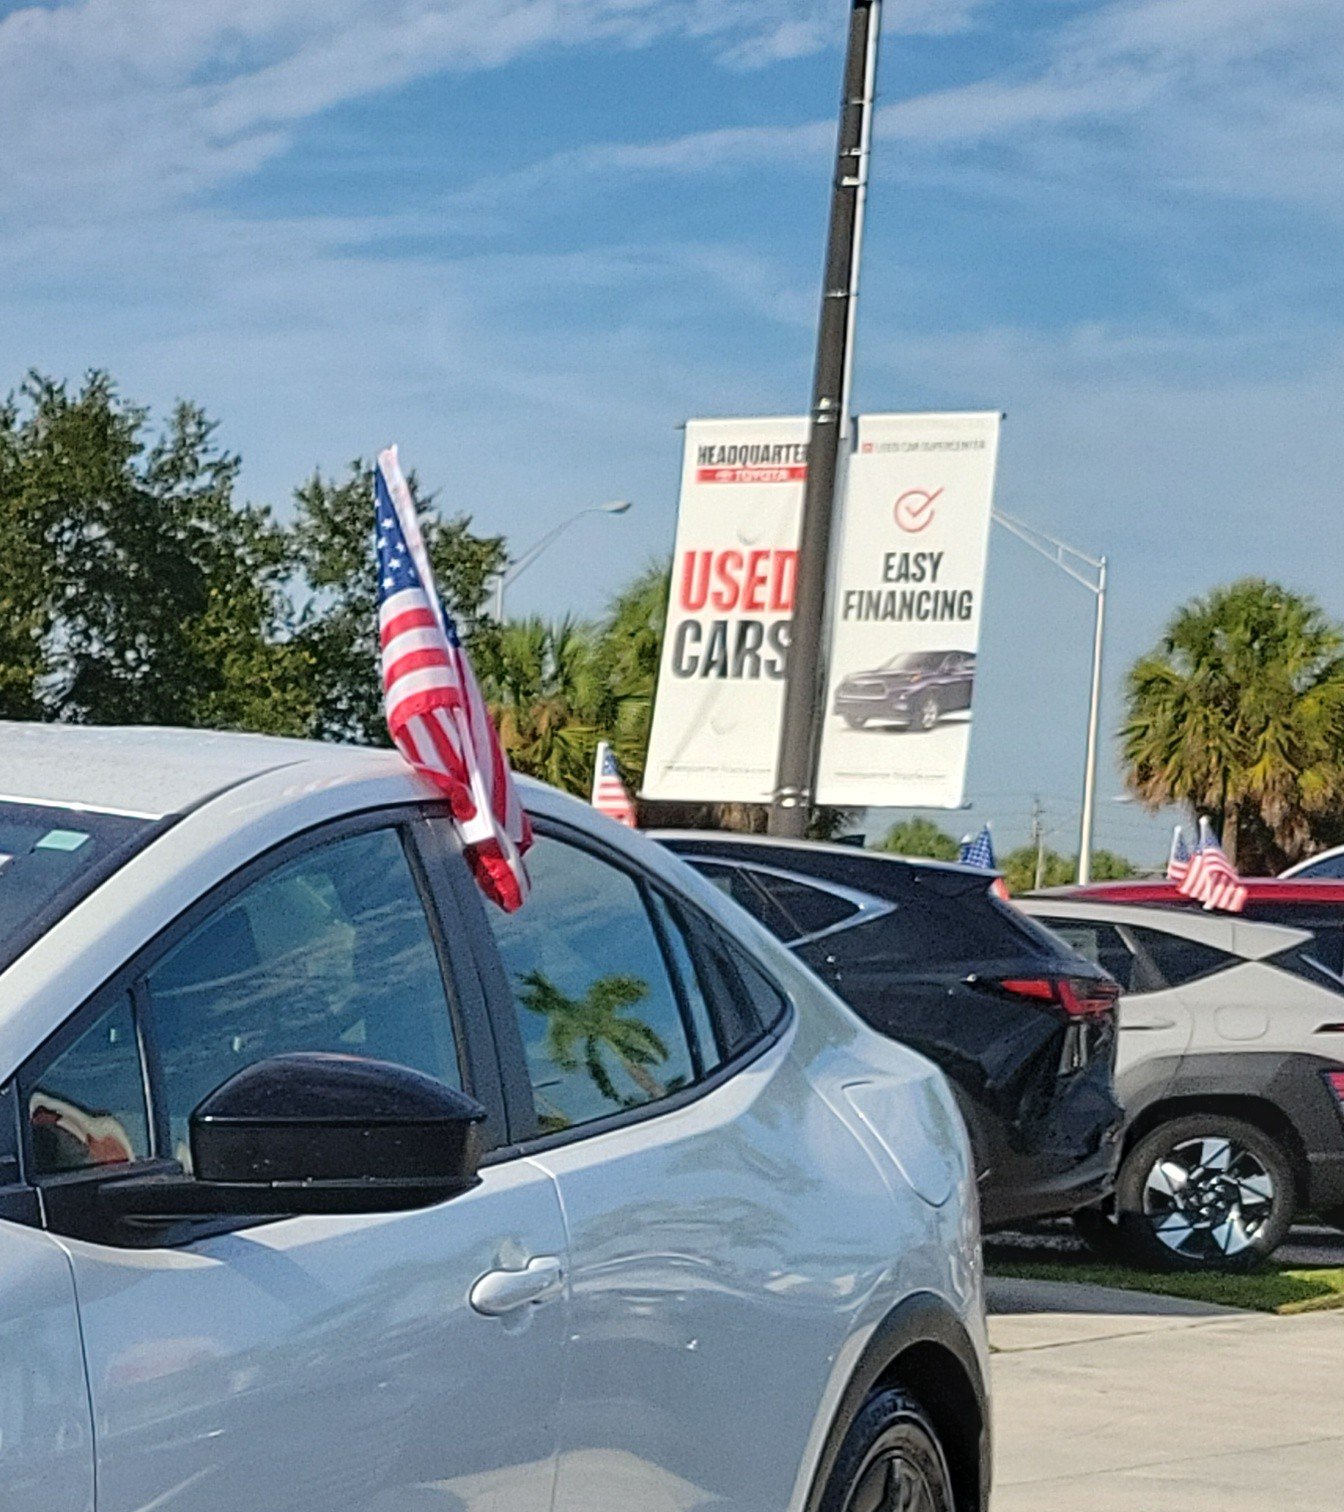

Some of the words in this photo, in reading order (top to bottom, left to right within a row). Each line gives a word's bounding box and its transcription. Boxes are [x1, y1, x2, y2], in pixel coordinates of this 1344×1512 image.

[680, 549, 800, 612] USED
[882, 551, 944, 583] EASY
[842, 589, 973, 621] FINANCING
[672, 619, 792, 679] CARS
